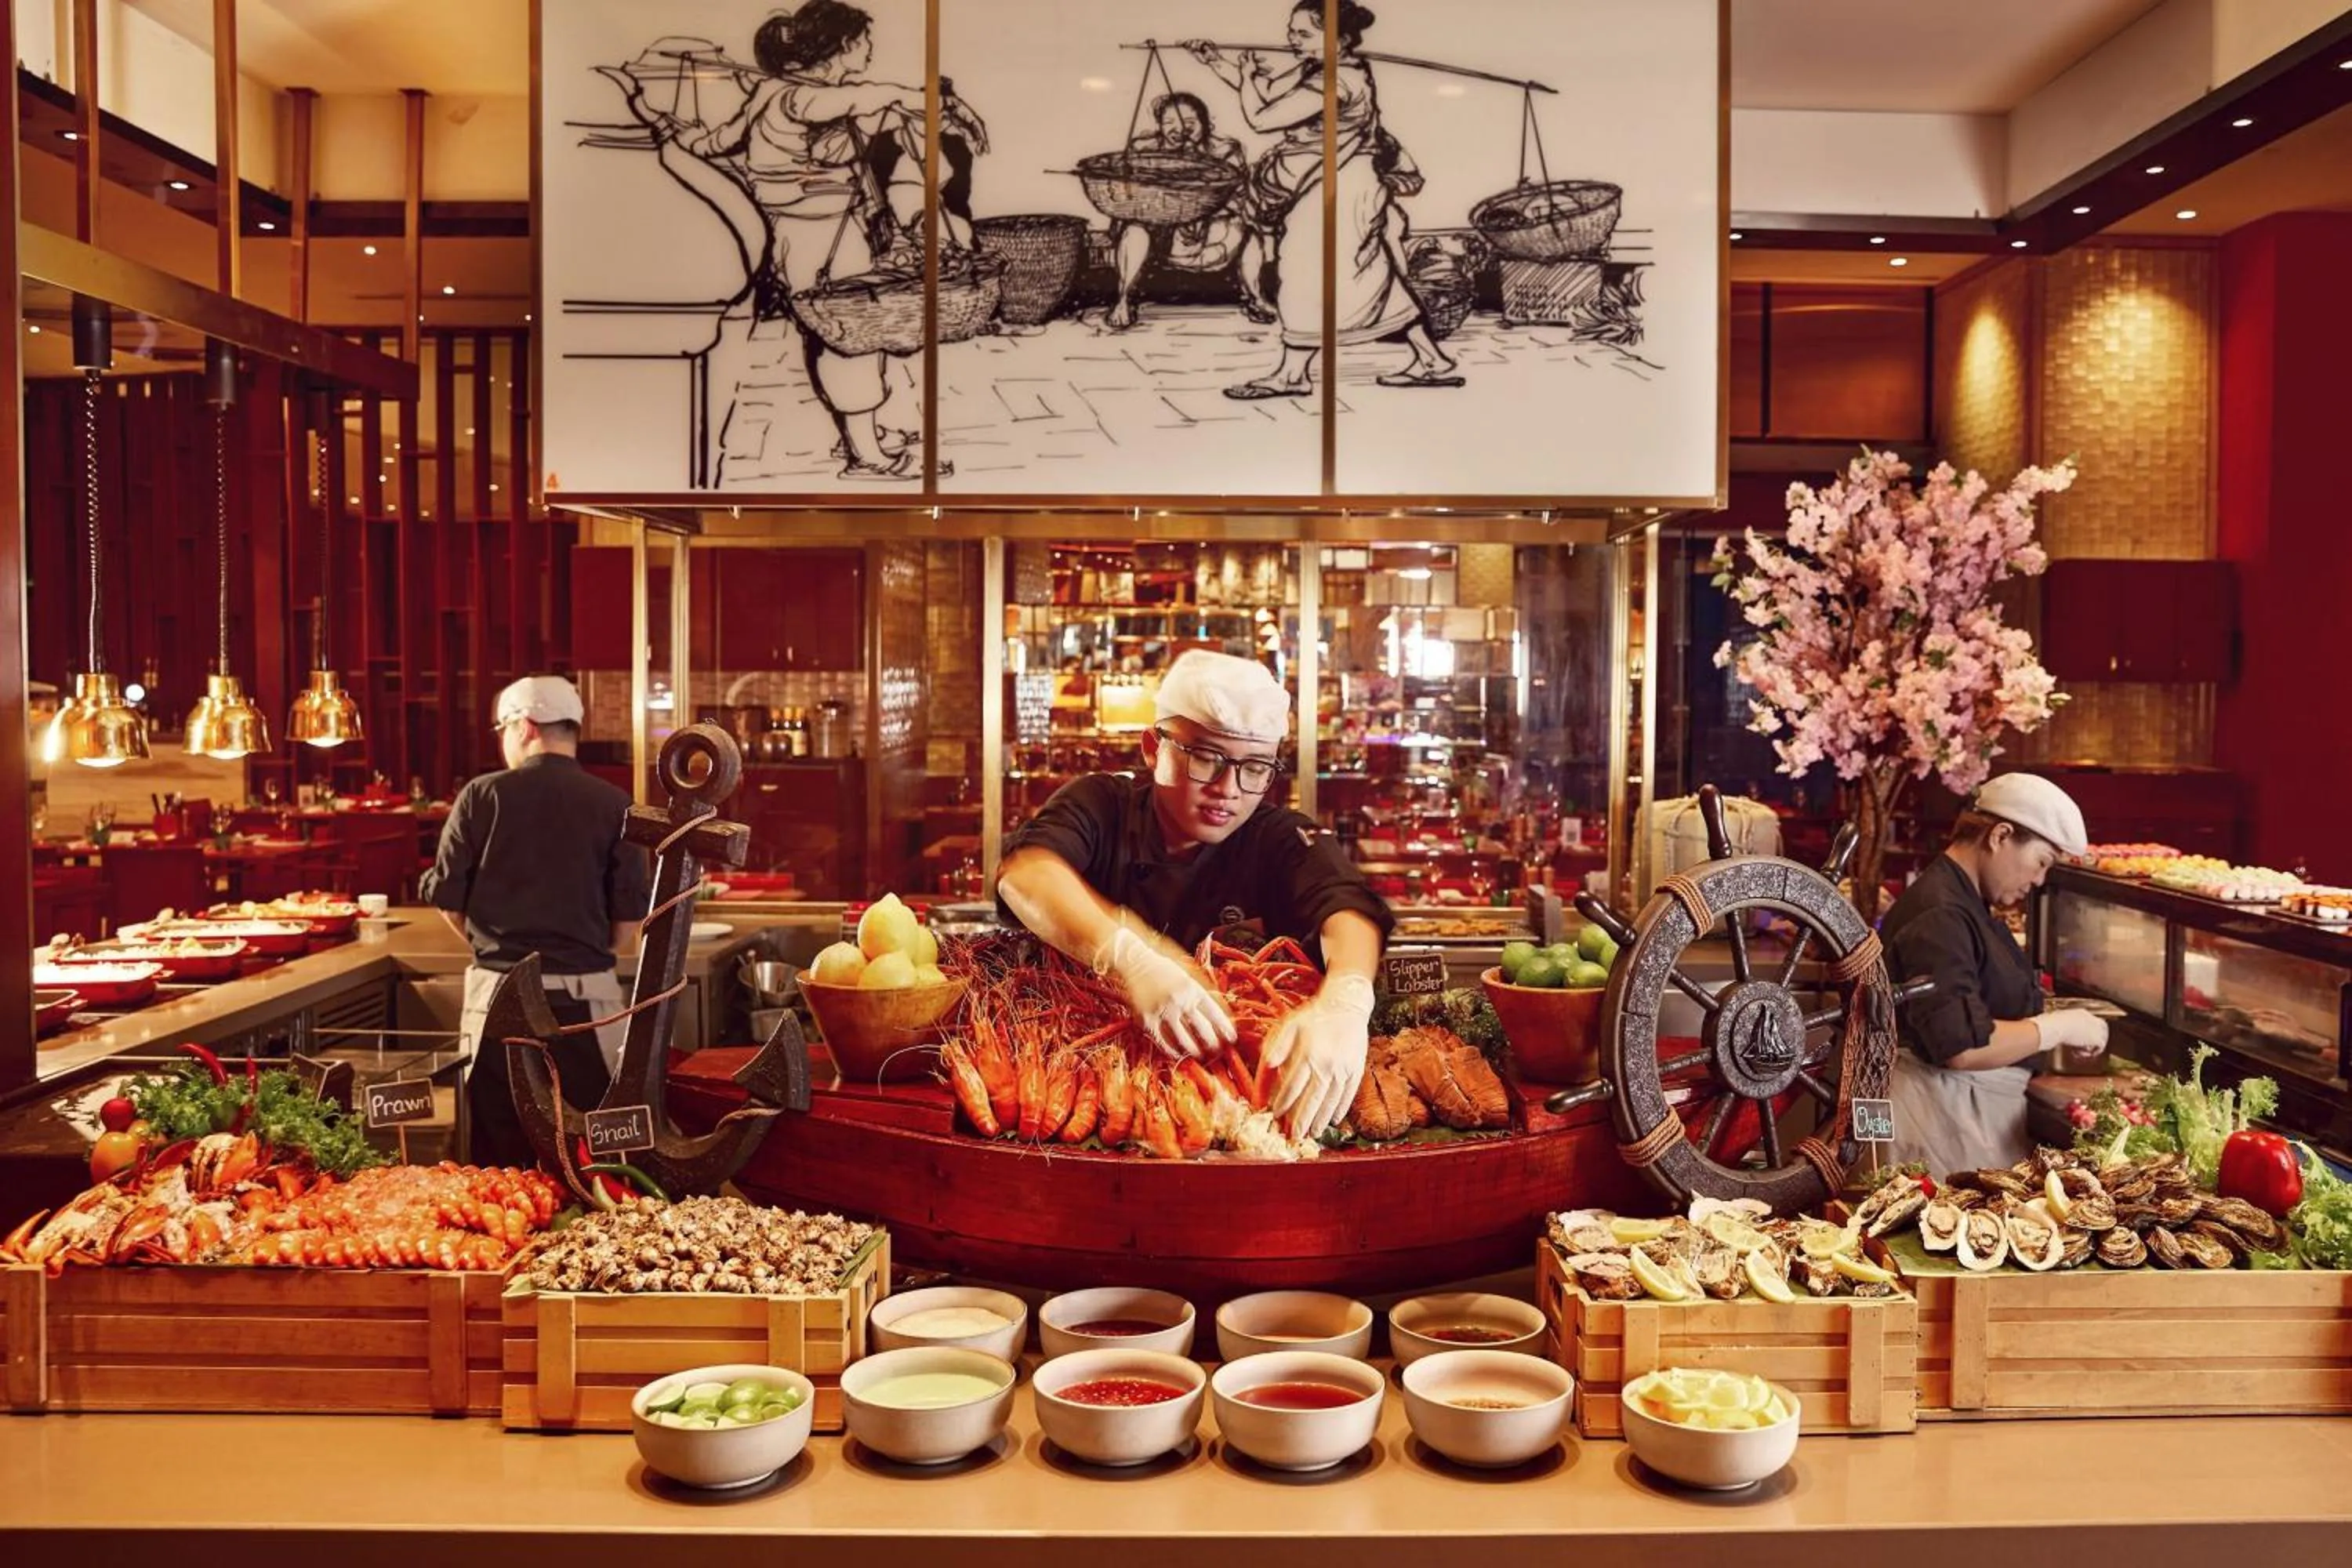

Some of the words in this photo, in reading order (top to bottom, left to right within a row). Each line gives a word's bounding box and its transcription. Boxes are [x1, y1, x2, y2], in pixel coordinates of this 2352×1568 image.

[1390, 959, 1439, 979] Slipper
[1395, 976, 1443, 993] Lobster
[372, 1095, 431, 1117] Prawn
[590, 1113, 641, 1145] Snail
